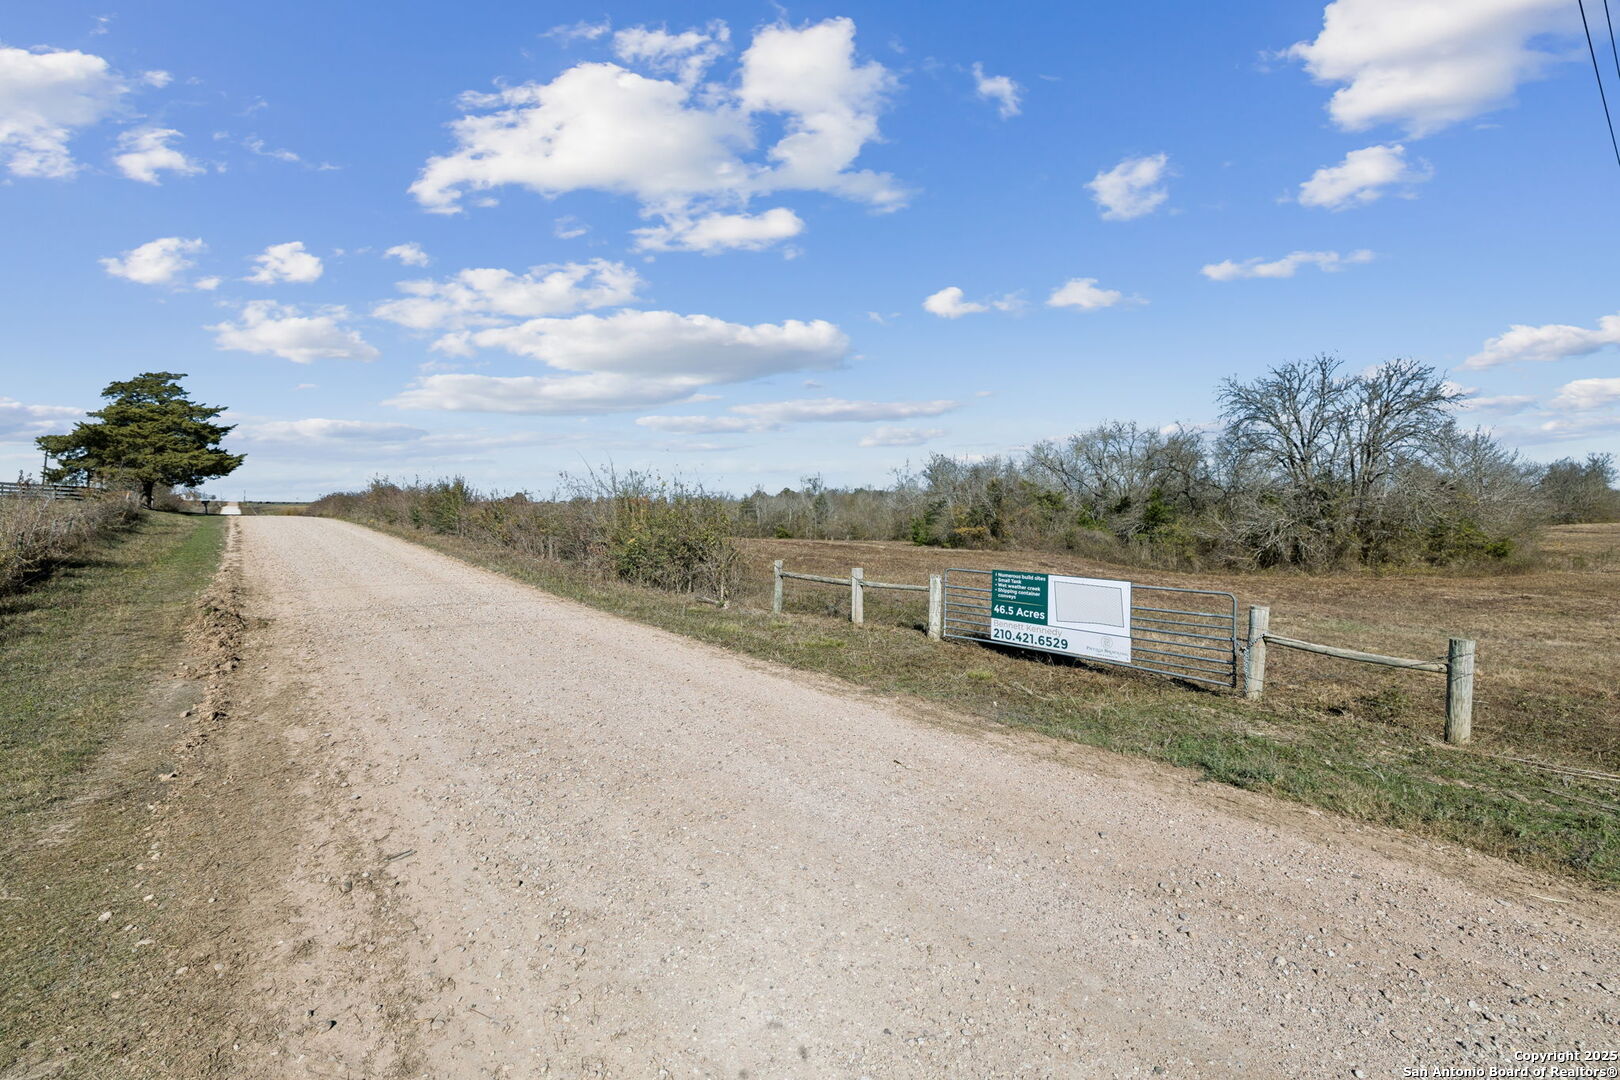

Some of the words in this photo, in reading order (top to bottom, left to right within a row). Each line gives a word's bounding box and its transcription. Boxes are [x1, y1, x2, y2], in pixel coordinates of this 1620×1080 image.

[994, 604, 1014, 616] 46.5
[1016, 607, 1046, 620] Acres
[993, 619, 1024, 631] Bennett
[1026, 625, 1063, 638] Kennedy
[993, 628, 1069, 650] 210.421.6529
